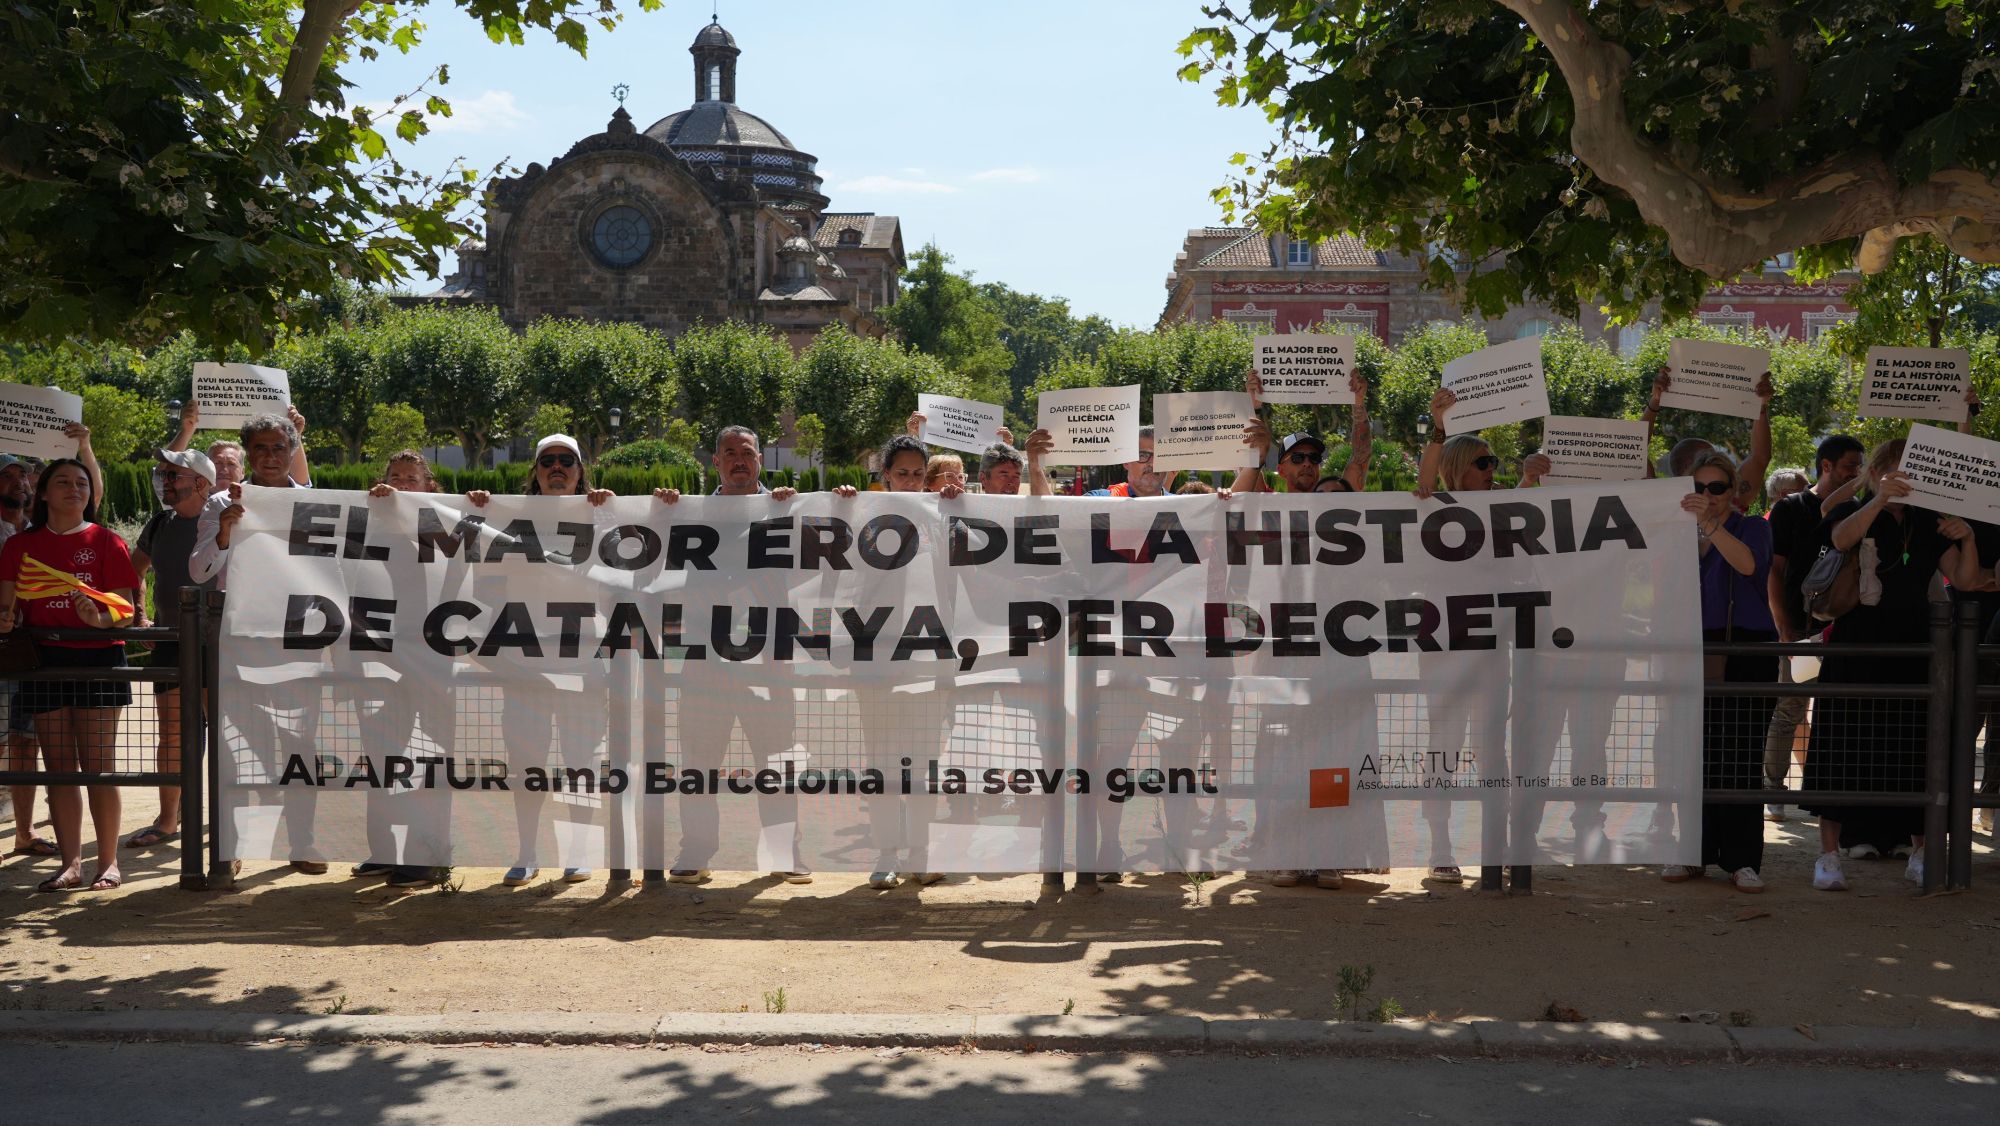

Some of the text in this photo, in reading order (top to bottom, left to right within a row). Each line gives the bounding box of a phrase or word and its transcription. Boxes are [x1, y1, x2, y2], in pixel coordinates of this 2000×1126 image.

[1262, 346, 1338, 354] EL MAJOR ERO
[1295, 355, 1344, 365] HISTÒRIA
[1876, 358, 1956, 370] EL MAJOR ERO
[1279, 368, 1345, 377] CATALUNYA,
[1480, 370, 1498, 379] PISOS
[1892, 371, 1907, 379] LA
[1910, 371, 1961, 381] HISTÒRIA
[218, 378, 266, 386] NOSALTRES.
[1285, 379, 1329, 387] DECRET.
[1456, 387, 1470, 395] MEU
[1890, 382, 1961, 394] CATALUNYA,
[1470, 388, 1500, 400] AQUESTA
[1870, 392, 1941, 402] PER DECRET.
[6, 401, 57, 415] NOSALTRES.
[928, 403, 962, 413] DARRERE
[974, 412, 994, 421] CADA
[1049, 402, 1131, 414] DARRERE DE CADA
[9, 409, 20, 417] LA
[22, 411, 44, 420] TEVA
[1067, 413, 1115, 422] LLICÈNCIA
[20, 419, 31, 427] EL
[32, 421, 49, 429] TEU
[1188, 424, 1216, 432] MILIONS
[14, 426, 36, 435] TAXI.
[1095, 426, 1115, 434] UNA
[1072, 435, 1110, 444] FAMÍLIA
[1557, 439, 1643, 451] DESPROPORCIONAT.
[1547, 448, 1560, 456] NO
[1573, 450, 1591, 458] UNA
[1592, 451, 1616, 460] BONA
[1911, 443, 1997, 469] AVUI NOSALTRES.
[1908, 452, 1937, 464] DEMÀ
[1939, 459, 1952, 468] LA
[1954, 463, 1980, 475] TEVA
[1905, 461, 2000, 489] DESPRÉS EL TEU BA
[1908, 472, 1968, 491] EL TEU TAXI.
[288, 493, 1647, 571] EL MAJOR ERO DE LA HISTÒRIA
[45, 599, 70, 609] .cat
[282, 590, 1575, 671] DE CATALUNYA, PER DECRET.
[1358, 751, 1477, 776] APARTUR
[279, 753, 1220, 803] APARTUR amb Barcelona i la seva gent
[1423, 777, 1512, 790] d'Apartaments
[1516, 775, 1569, 788] Turístics
[1572, 775, 1587, 786] de
[1590, 774, 1651, 787] Barcelona
